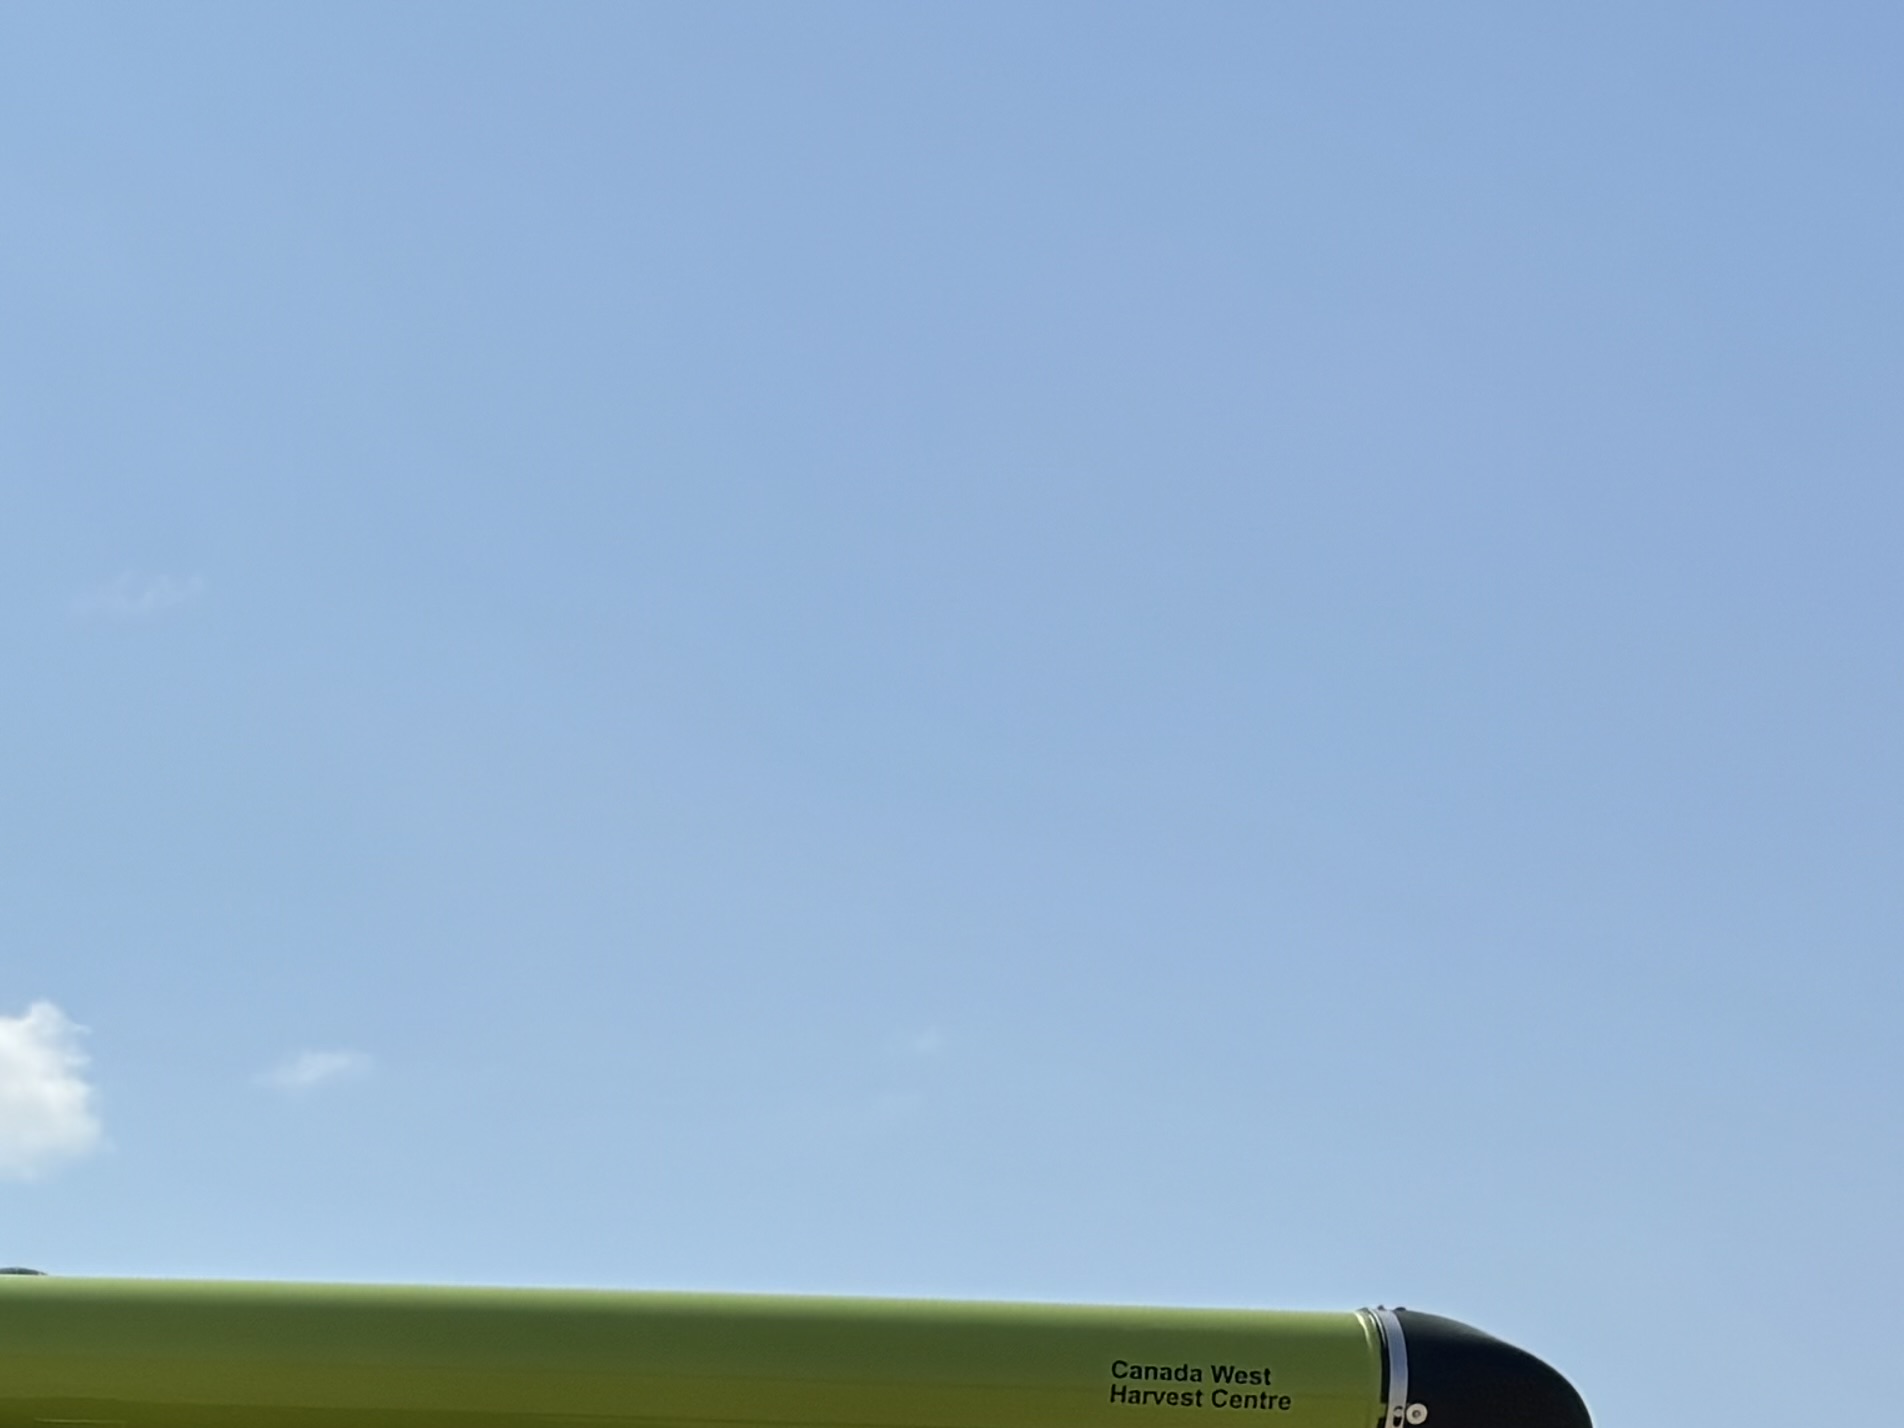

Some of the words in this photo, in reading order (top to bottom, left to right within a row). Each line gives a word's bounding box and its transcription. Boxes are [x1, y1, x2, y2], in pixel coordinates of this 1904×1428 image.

[1111, 1360, 1202, 1382] Canada
[1211, 1365, 1271, 1386] West
[1109, 1384, 1203, 1408] Harvest
[1211, 1389, 1291, 1411] Centre
